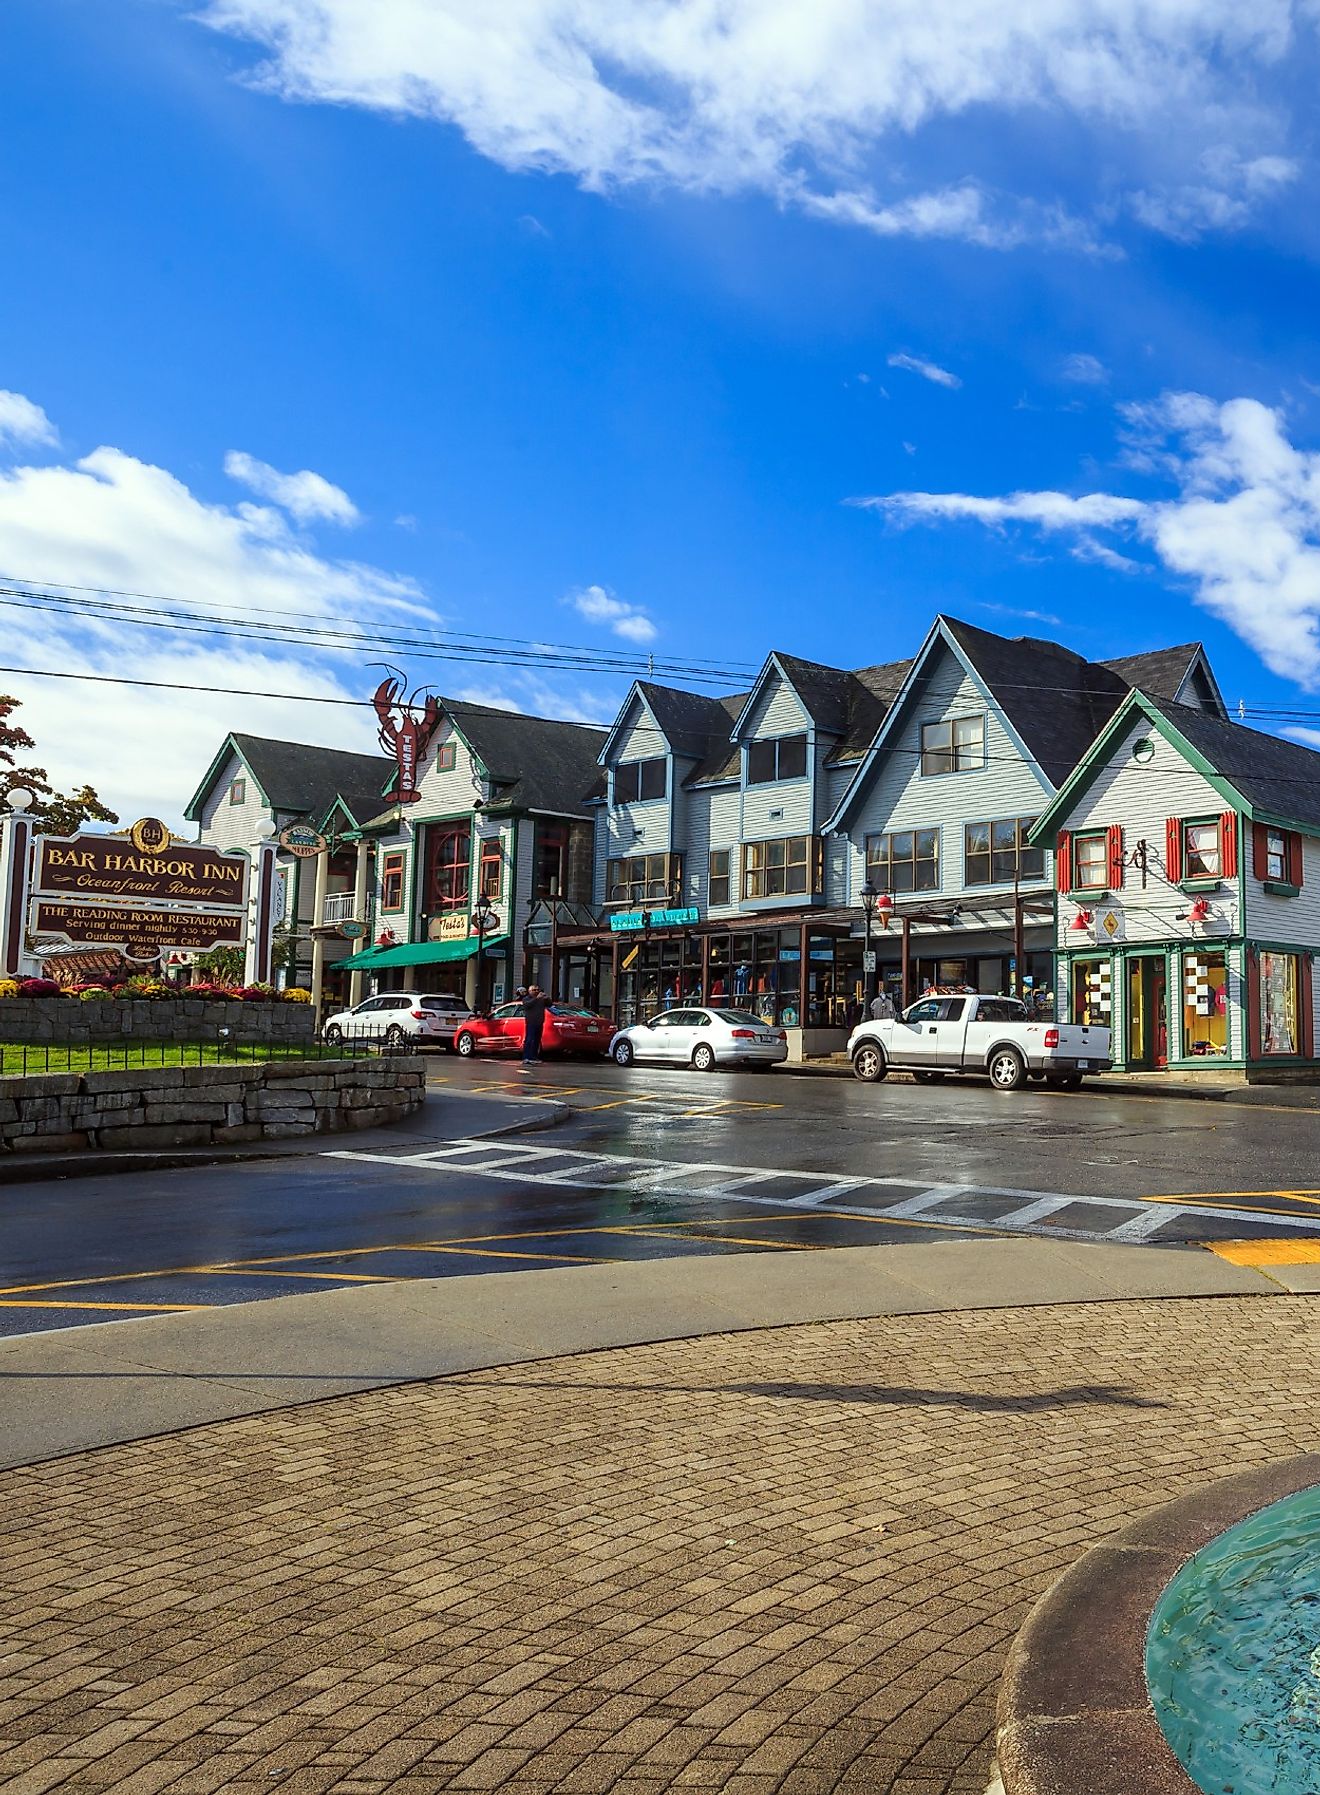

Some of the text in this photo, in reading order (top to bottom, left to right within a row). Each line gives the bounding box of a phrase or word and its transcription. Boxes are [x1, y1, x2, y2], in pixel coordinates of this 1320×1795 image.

[47, 848, 240, 882] BAR HARBOR INN
[76, 873, 215, 896] Oceanfront Resort
[42, 905, 239, 928] THE READING ROOM RESTAURANT
[65, 918, 106, 930] Serving
[109, 921, 141, 932] dinner
[144, 923, 178, 933] nightly
[85, 931, 201, 946] Outdoor Waterfront Cafe
